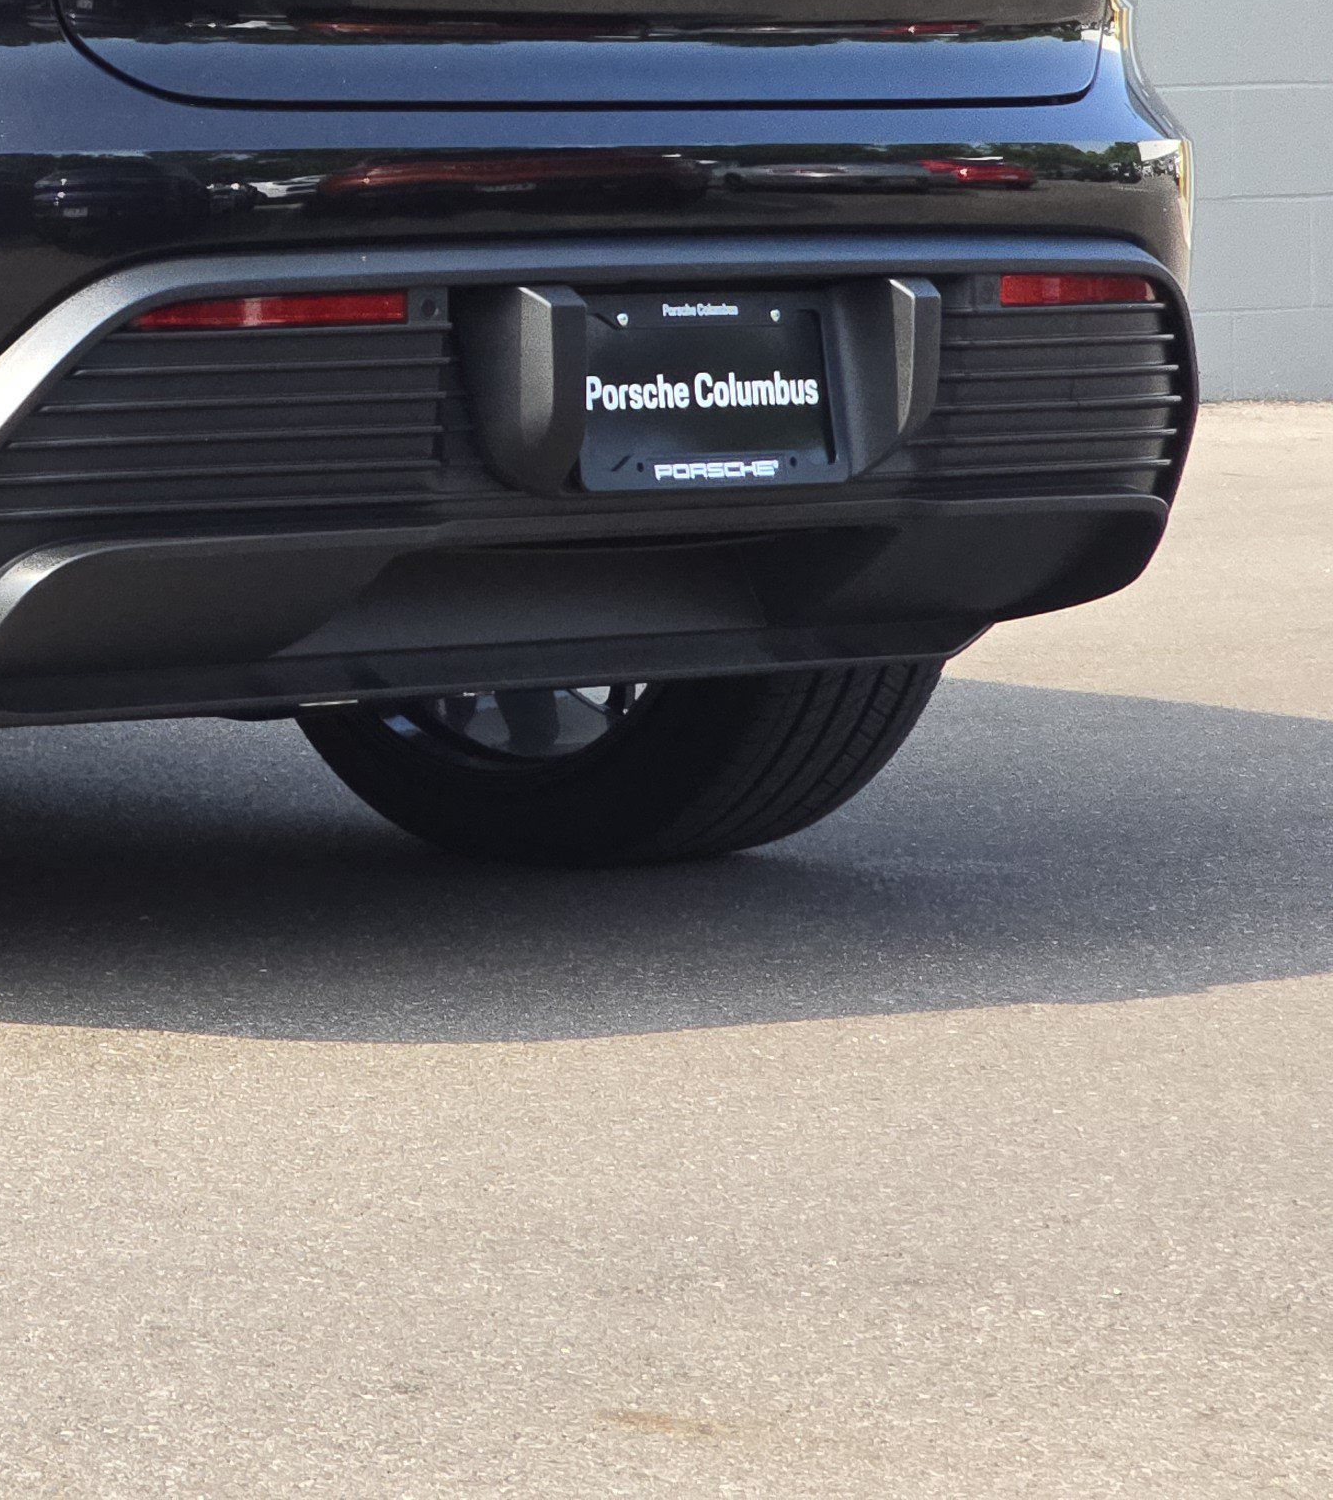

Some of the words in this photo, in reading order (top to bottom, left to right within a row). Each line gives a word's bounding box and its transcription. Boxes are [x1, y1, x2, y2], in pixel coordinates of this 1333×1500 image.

[662, 303, 696, 317] Porsche
[585, 374, 690, 411] Porsche
[694, 370, 820, 409] Columbus
[653, 459, 776, 481] PORSCHE
